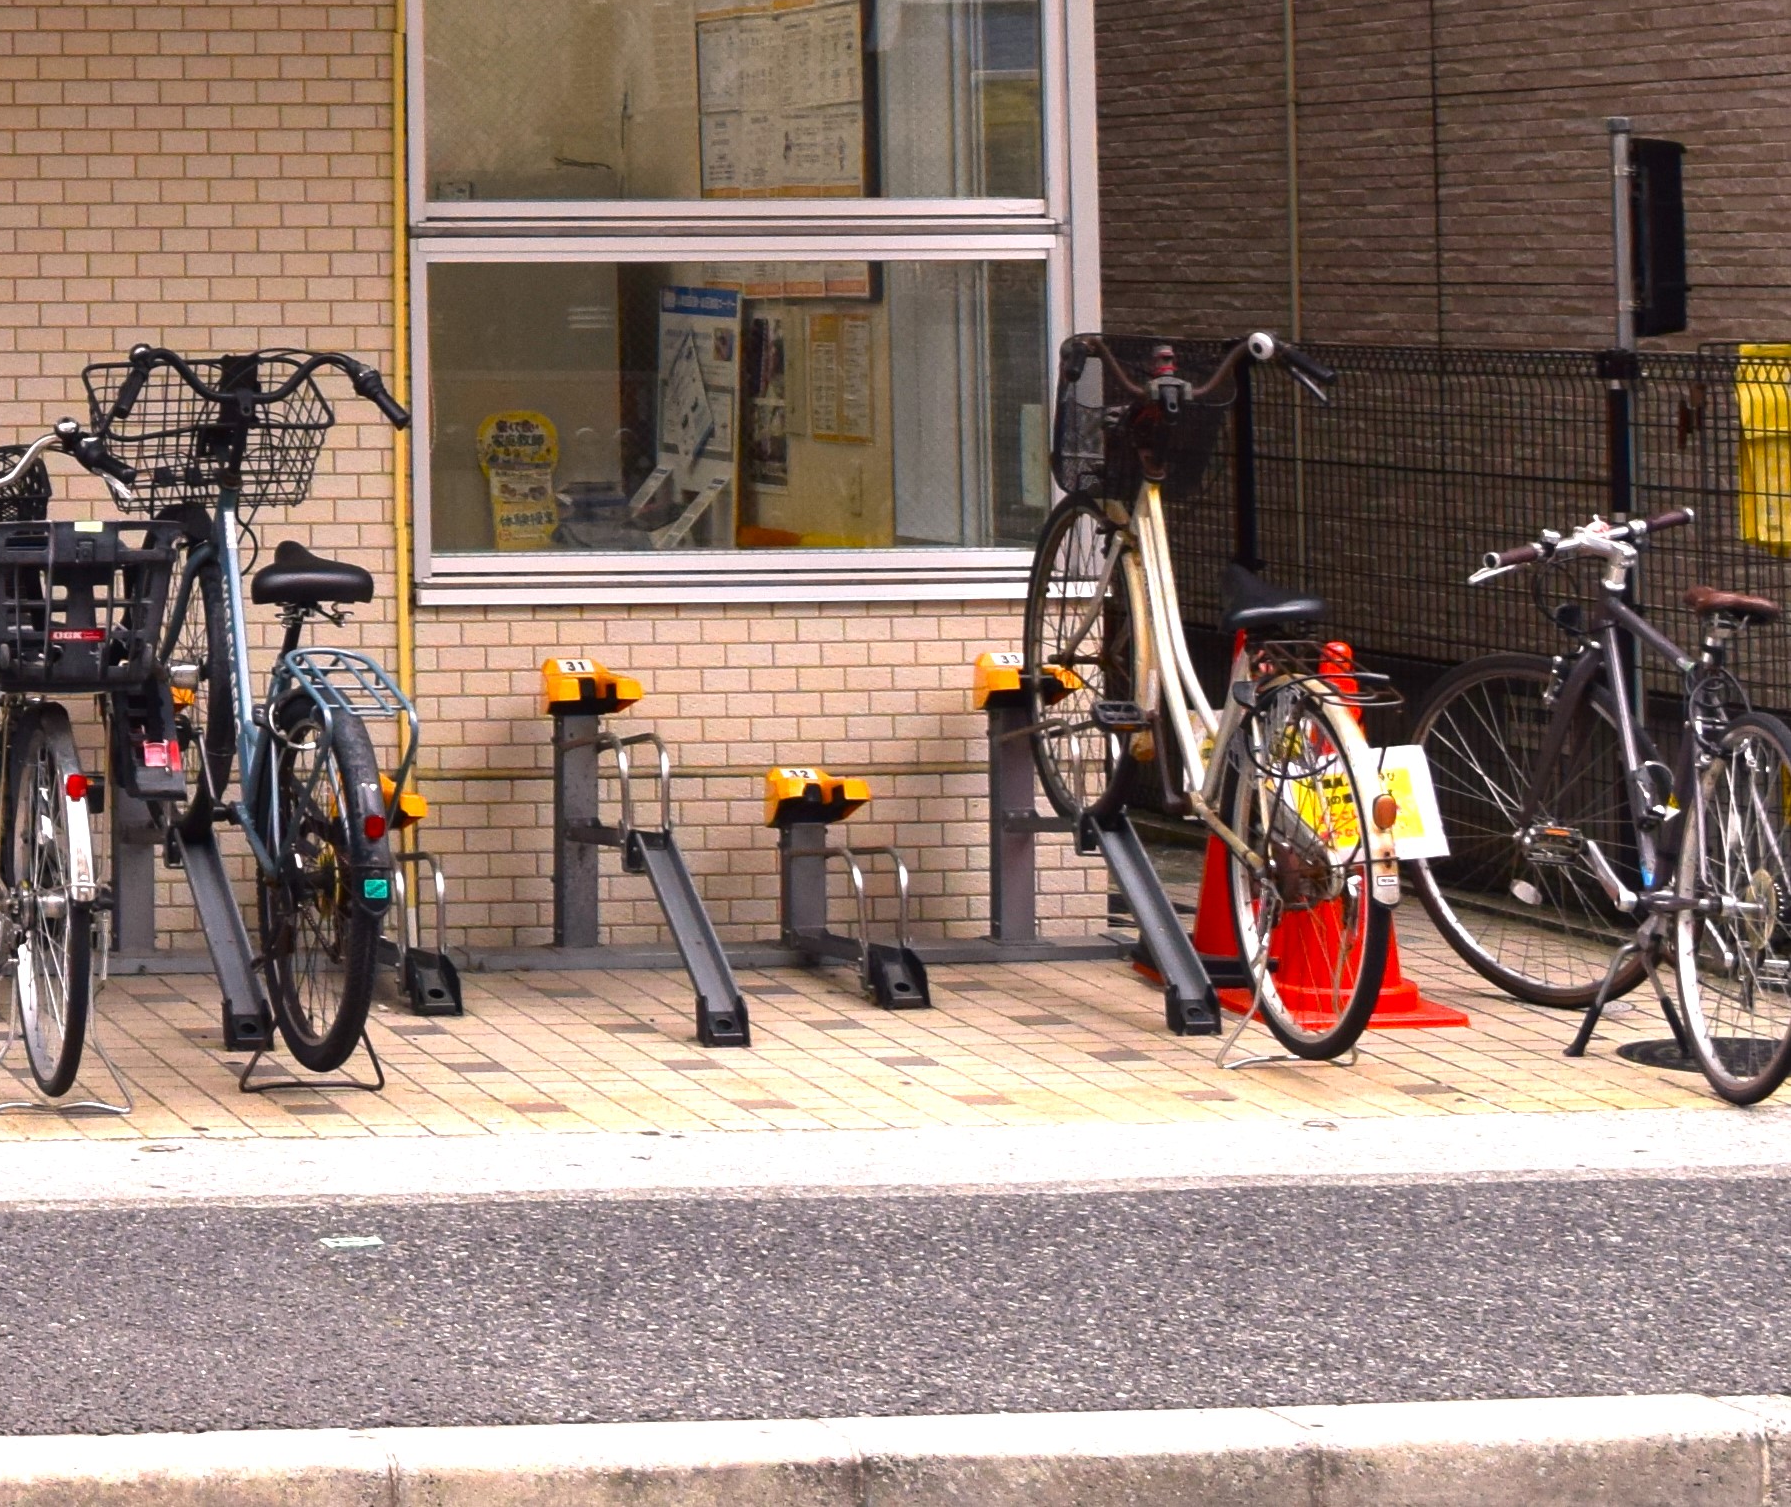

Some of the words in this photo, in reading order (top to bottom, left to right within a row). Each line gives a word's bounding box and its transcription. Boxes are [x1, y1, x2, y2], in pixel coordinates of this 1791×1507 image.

[52, 631, 83, 640] OGK
[1002, 654, 1021, 665] 33
[566, 661, 586, 672] 31
[789, 770, 810, 780] 32
